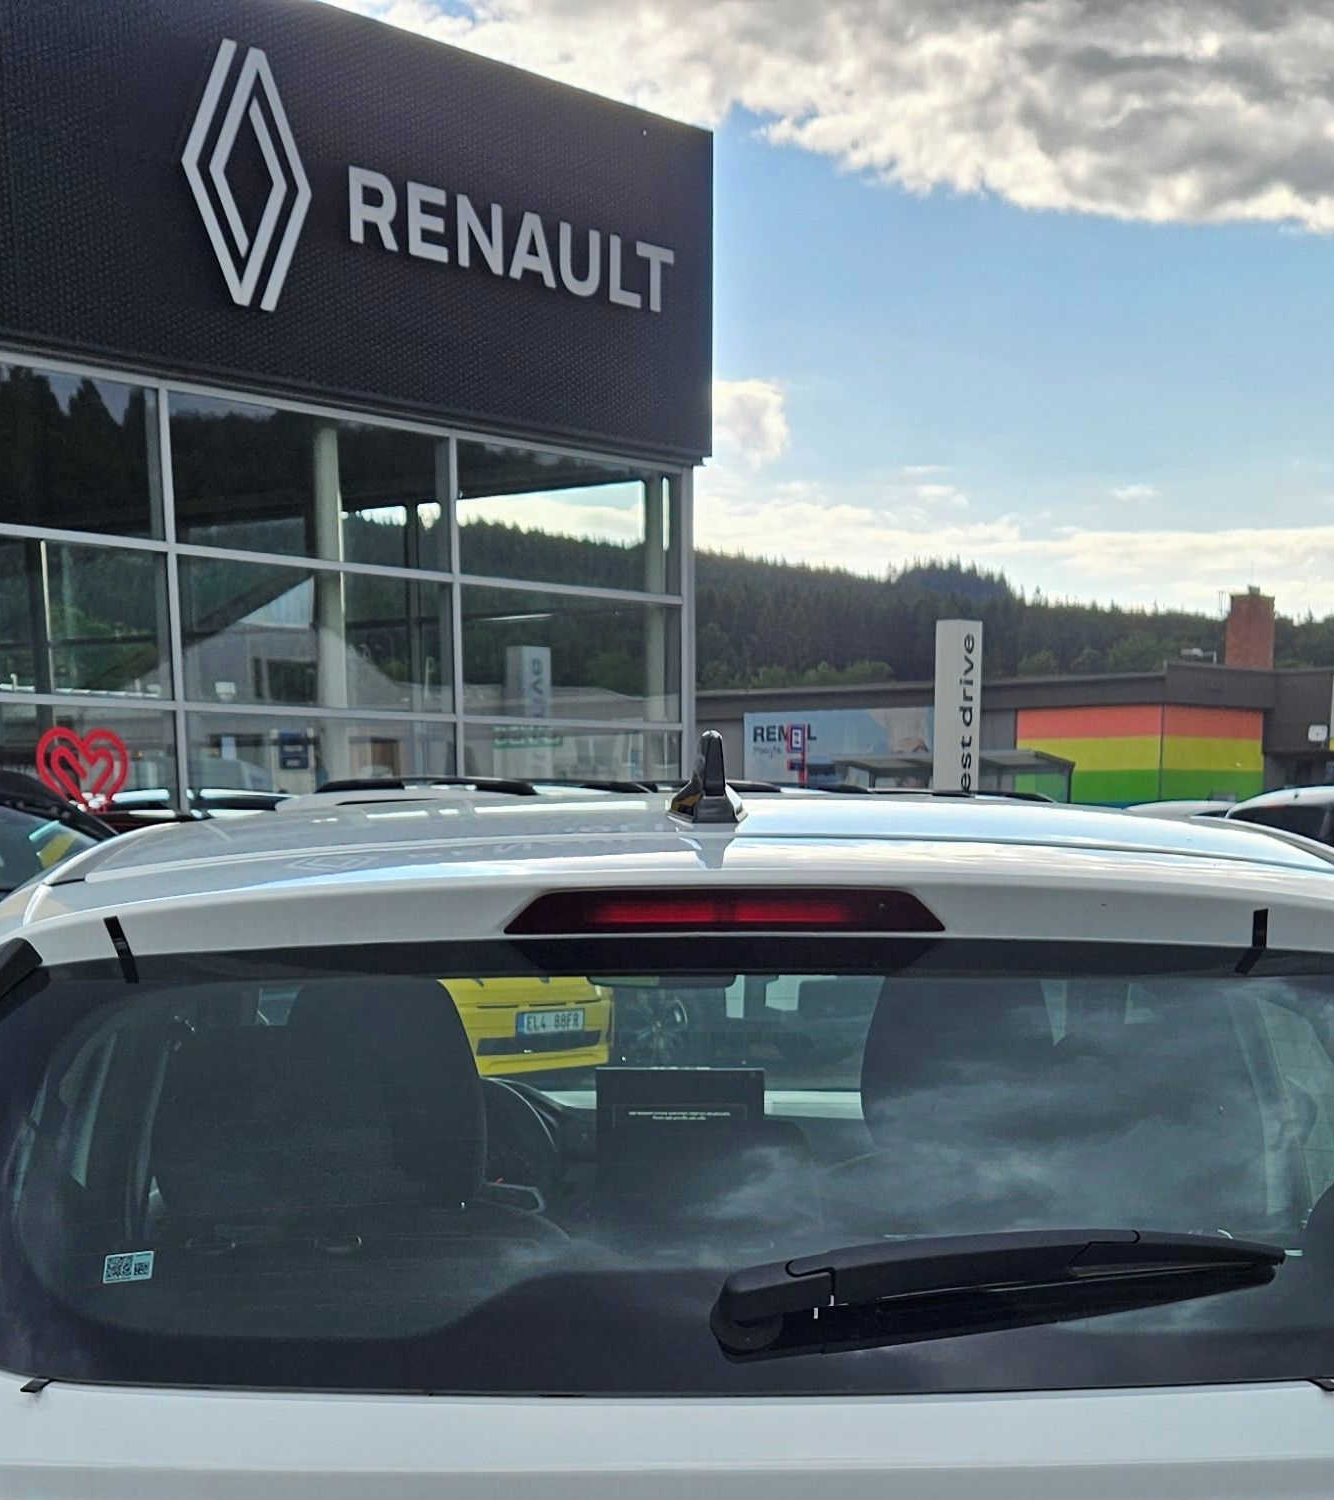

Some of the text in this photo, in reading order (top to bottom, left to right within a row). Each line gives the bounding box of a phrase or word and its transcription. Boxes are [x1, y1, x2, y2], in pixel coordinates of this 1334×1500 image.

[348, 164, 675, 313] RENAULT
[753, 725, 817, 743] RENL
[959, 633, 975, 794] est drive
